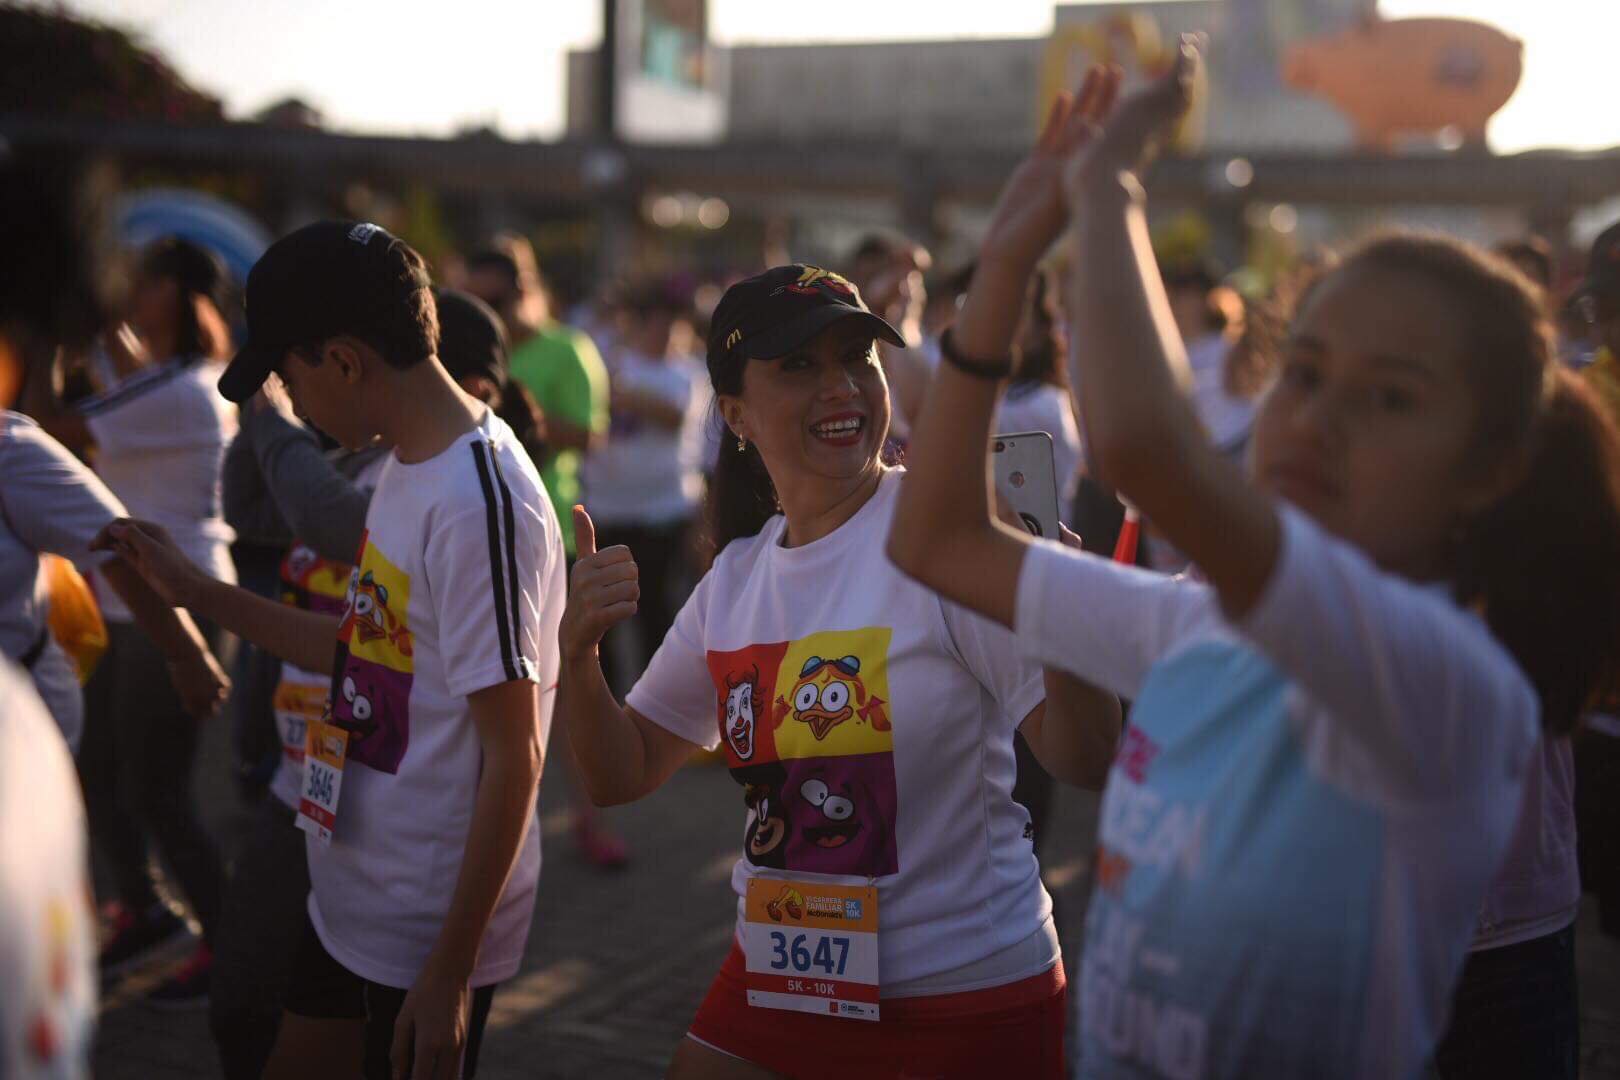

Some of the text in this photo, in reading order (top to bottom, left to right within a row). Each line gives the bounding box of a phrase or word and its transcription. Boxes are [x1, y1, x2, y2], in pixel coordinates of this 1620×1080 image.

[307, 763, 334, 806] 3646
[806, 903, 843, 912] FAMILIAR
[845, 901, 856, 909] 5K
[846, 909, 861, 918] 10K
[770, 931, 850, 975] 3647
[787, 979, 804, 992] 5K
[814, 982, 835, 995] 10K
